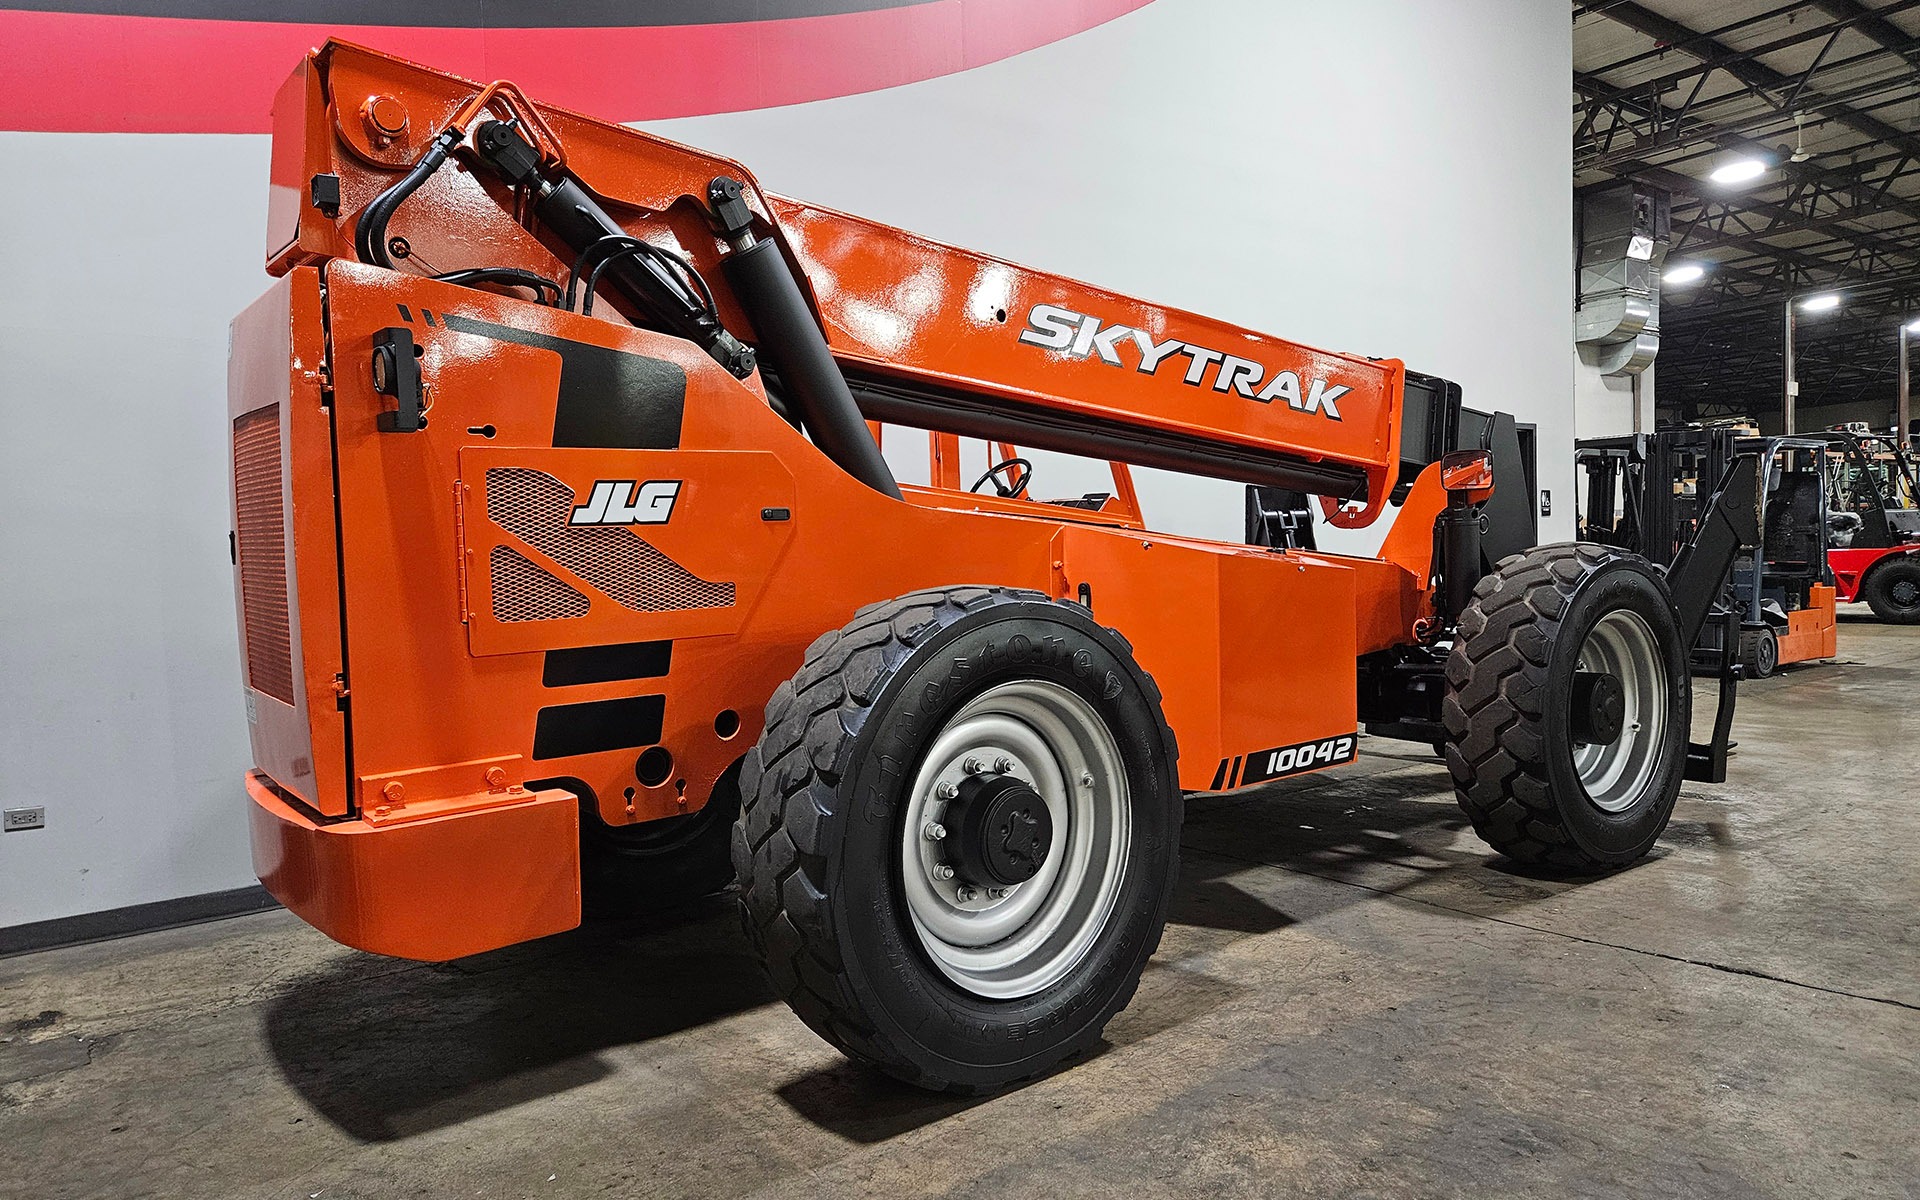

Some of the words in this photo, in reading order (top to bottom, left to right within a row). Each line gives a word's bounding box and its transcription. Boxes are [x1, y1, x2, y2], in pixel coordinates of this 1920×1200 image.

[1018, 303, 1354, 422] SKYTRAK
[567, 480, 683, 526] JLG
[862, 633, 1093, 824] Firestone
[1266, 737, 1352, 774] 10042
